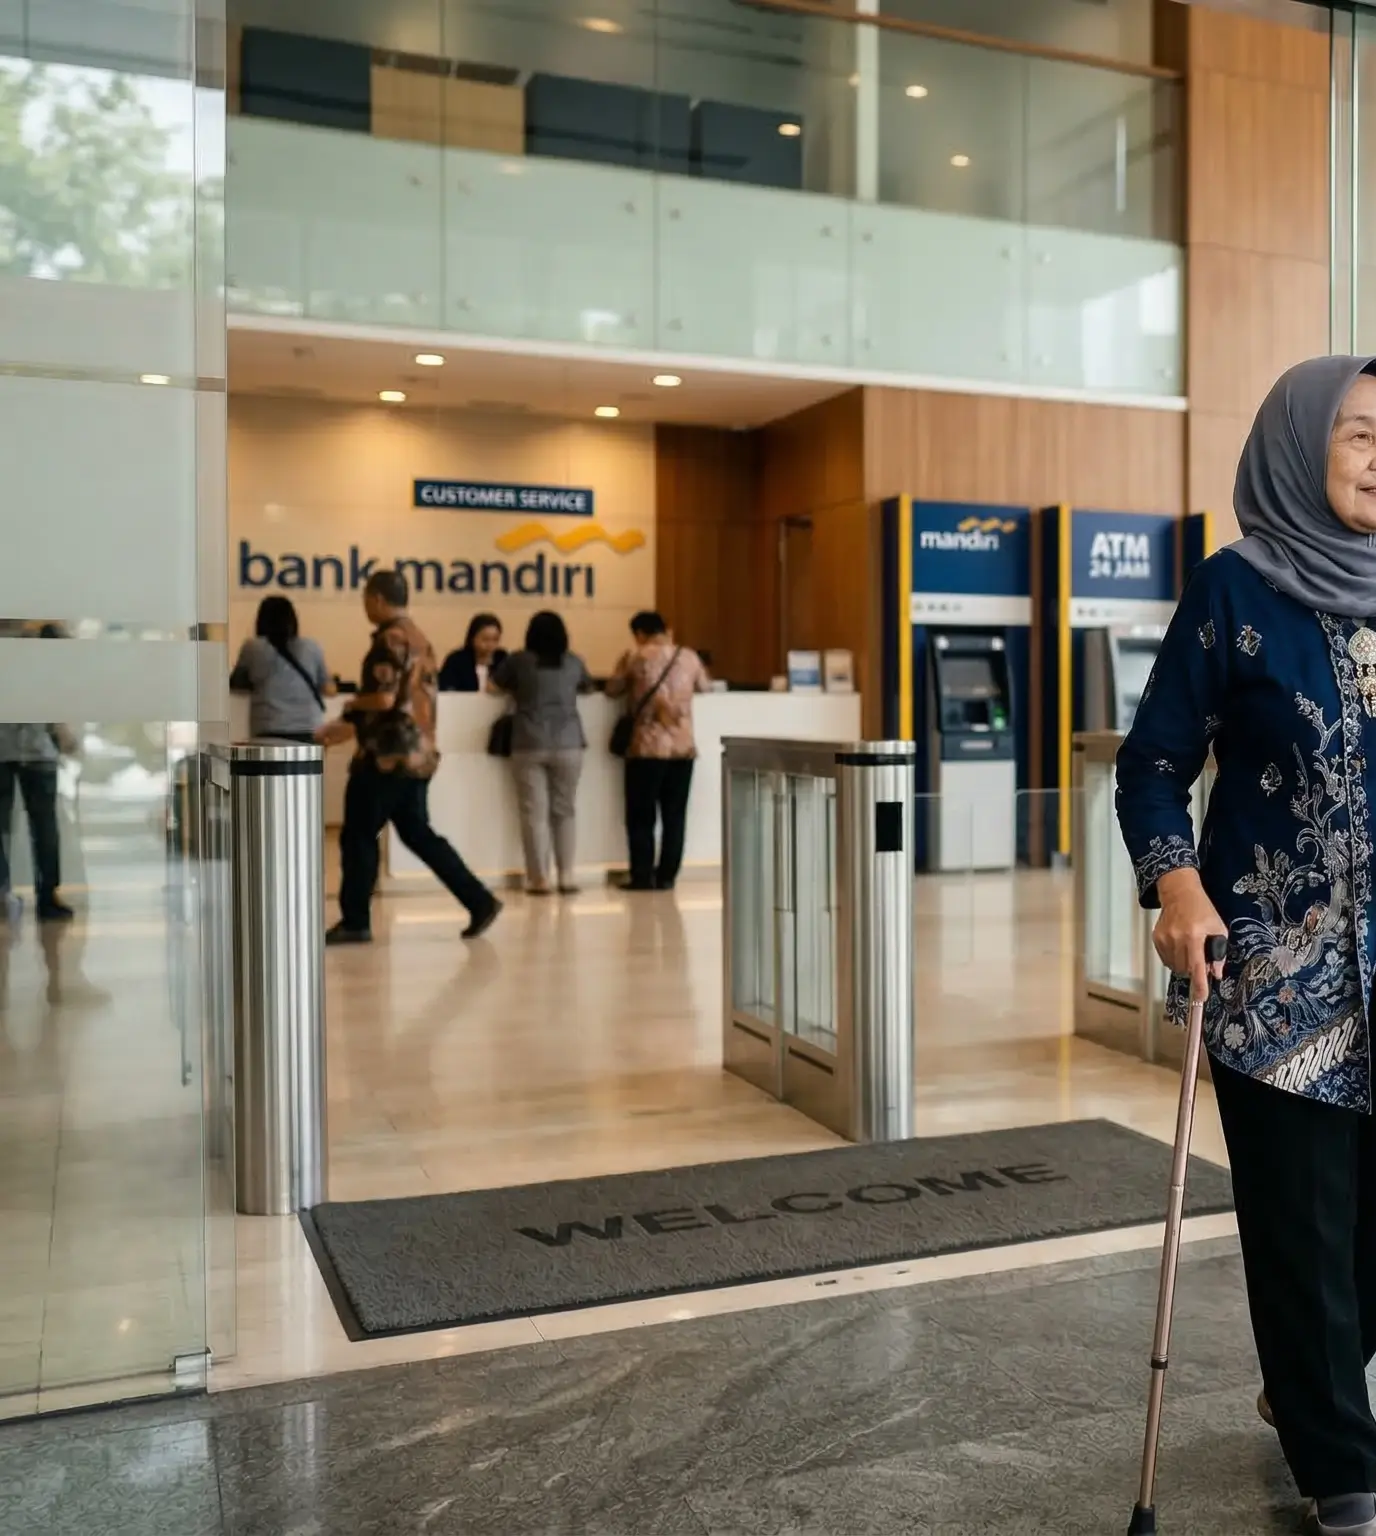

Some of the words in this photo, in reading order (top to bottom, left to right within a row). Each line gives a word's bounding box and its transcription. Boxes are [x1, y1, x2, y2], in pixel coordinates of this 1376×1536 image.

[421, 484, 517, 508] CUSTOMER
[519, 489, 587, 511] SERVICE
[1091, 531, 1150, 560] ATM
[239, 539, 379, 589] bank
[394, 552, 594, 597] mandiri
[1089, 560, 1111, 578] 24
[1113, 560, 1150, 579] JAM
[513, 1162, 1069, 1247] WELCOME
